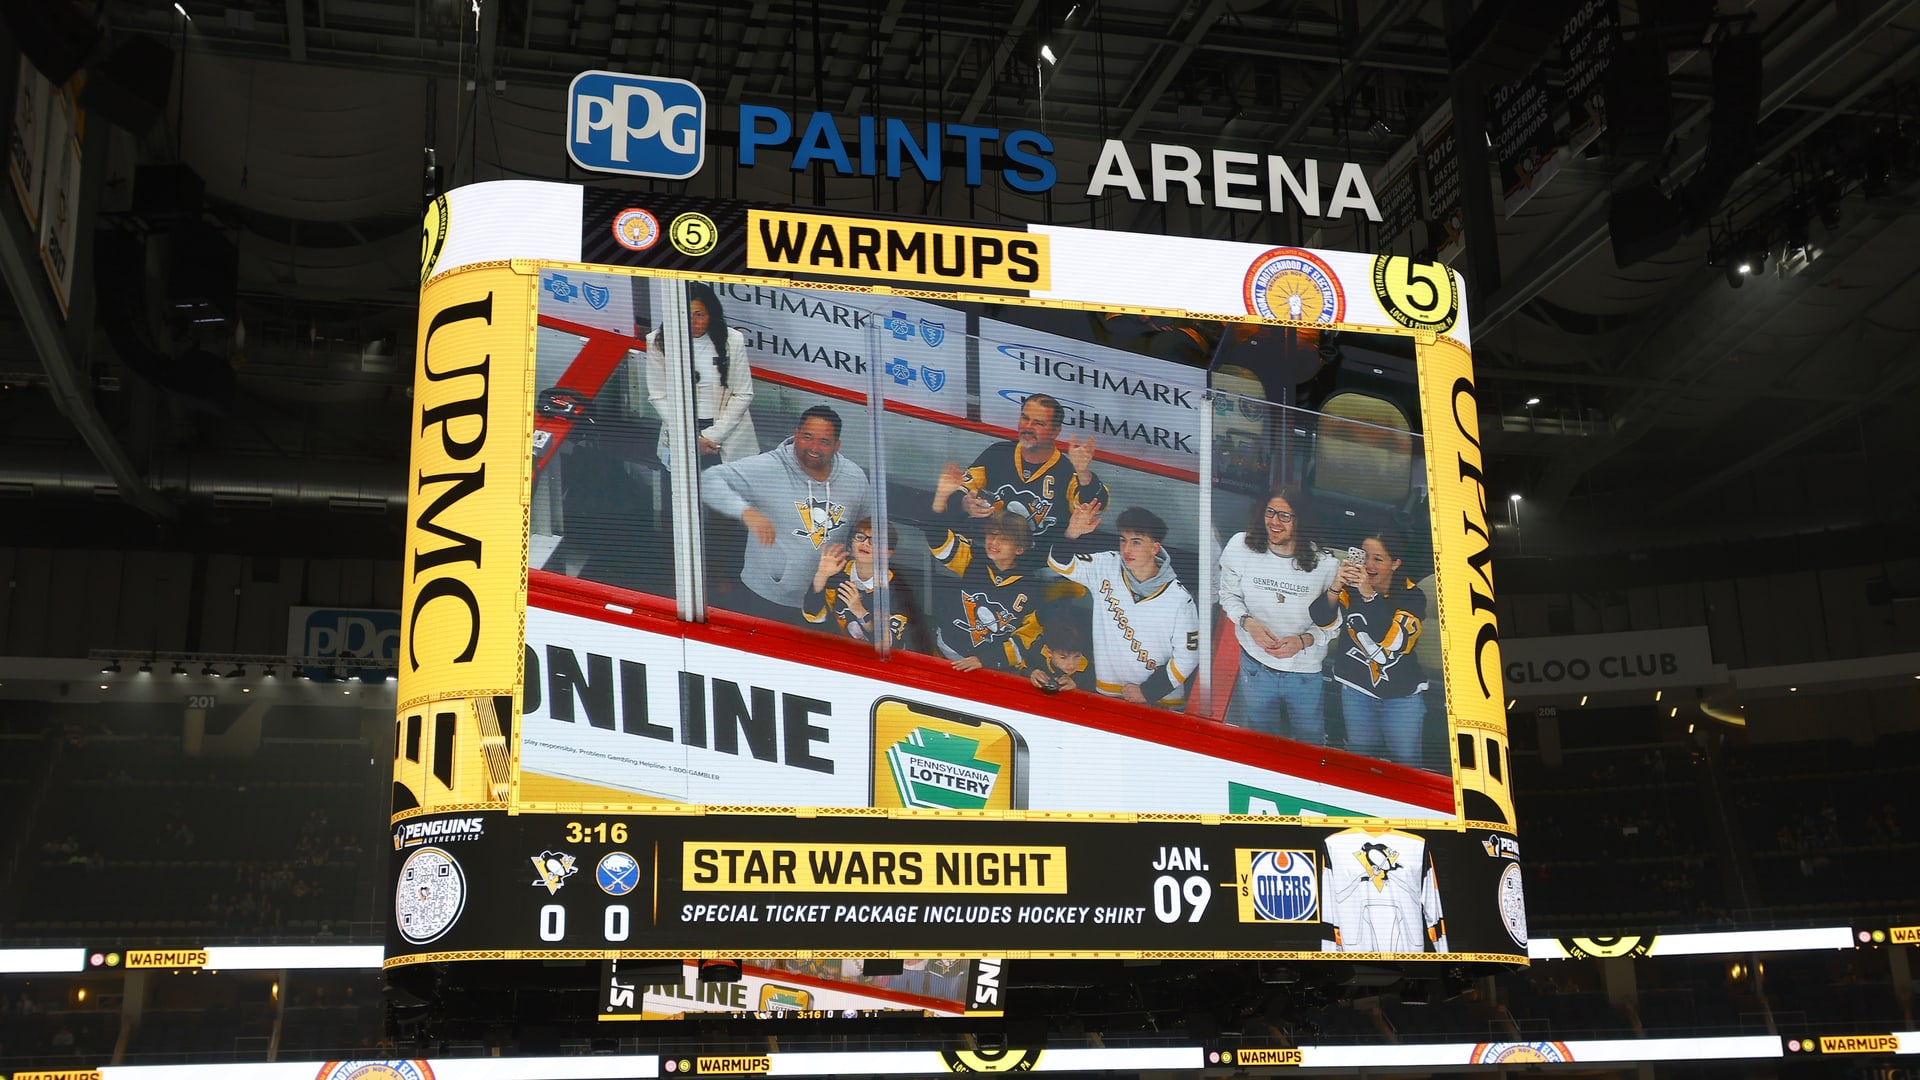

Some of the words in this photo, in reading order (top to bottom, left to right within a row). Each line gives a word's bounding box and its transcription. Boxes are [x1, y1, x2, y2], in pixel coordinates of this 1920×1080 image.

[575, 84, 699, 164] PPG
[737, 103, 1058, 193] PAINTS
[1086, 139, 1384, 223] ARENA
[1427, 136, 1456, 171] 2016-
[685, 222, 701, 245] 5
[759, 219, 1040, 283] WARMUPS
[1257, 260, 1302, 287] BROTHERHOOD
[1302, 263, 1314, 274] OF
[1311, 271, 1334, 312] ELECTRICAL
[1406, 256, 1439, 312] 5
[1389, 307, 1408, 325] LOCAL
[733, 326, 866, 375] GHMARK
[1019, 351, 1193, 410] HIGHMARK
[1020, 395, 1193, 454] GHMARK
[409, 290, 494, 673] UPMC
[1042, 475, 1056, 500] C
[1252, 577, 1279, 588] GENEVA
[1279, 581, 1310, 593] COLLEGE
[1012, 593, 1028, 613] C
[1099, 579, 1157, 671] PITTSBURG
[1186, 630, 1199, 651] 5
[1505, 659, 1590, 684] GLOO
[1598, 653, 1678, 679] CLUB
[188, 695, 215, 708] 201
[1538, 707, 1556, 717] 206
[579, 748, 606, 759] Problem
[607, 753, 638, 767] Gambling
[910, 757, 990, 782] PENNSYLVANIA
[909, 767, 990, 795] LOTTERY
[405, 817, 484, 840] PENGUINS
[422, 833, 480, 844] AUTHENTICS
[565, 821, 629, 844] 3:16
[693, 848, 797, 884] STAR
[809, 850, 923, 886] WARS
[936, 852, 1052, 887] NIGHT
[1152, 846, 1210, 871] JAN.
[1153, 875, 1212, 924] 09
[1257, 874, 1311, 920] OILERS
[539, 904, 566, 942] 0
[604, 904, 630, 942] 0
[680, 904, 760, 923] SPECIAL
[764, 905, 831, 923] TICKET
[834, 905, 918, 924] PACKAGE
[922, 906, 1013, 925] INCLUDES
[1017, 906, 1090, 925] HOCKEY
[1092, 906, 1147, 925] SHIRT
[129, 952, 207, 966] WARMUPS
[797, 1011, 821, 1019] 3:16
[1823, 1037, 1898, 1050] WARMUPS
[699, 1058, 770, 1072] WARMUPS
[1240, 1051, 1302, 1064] WARMUPS
